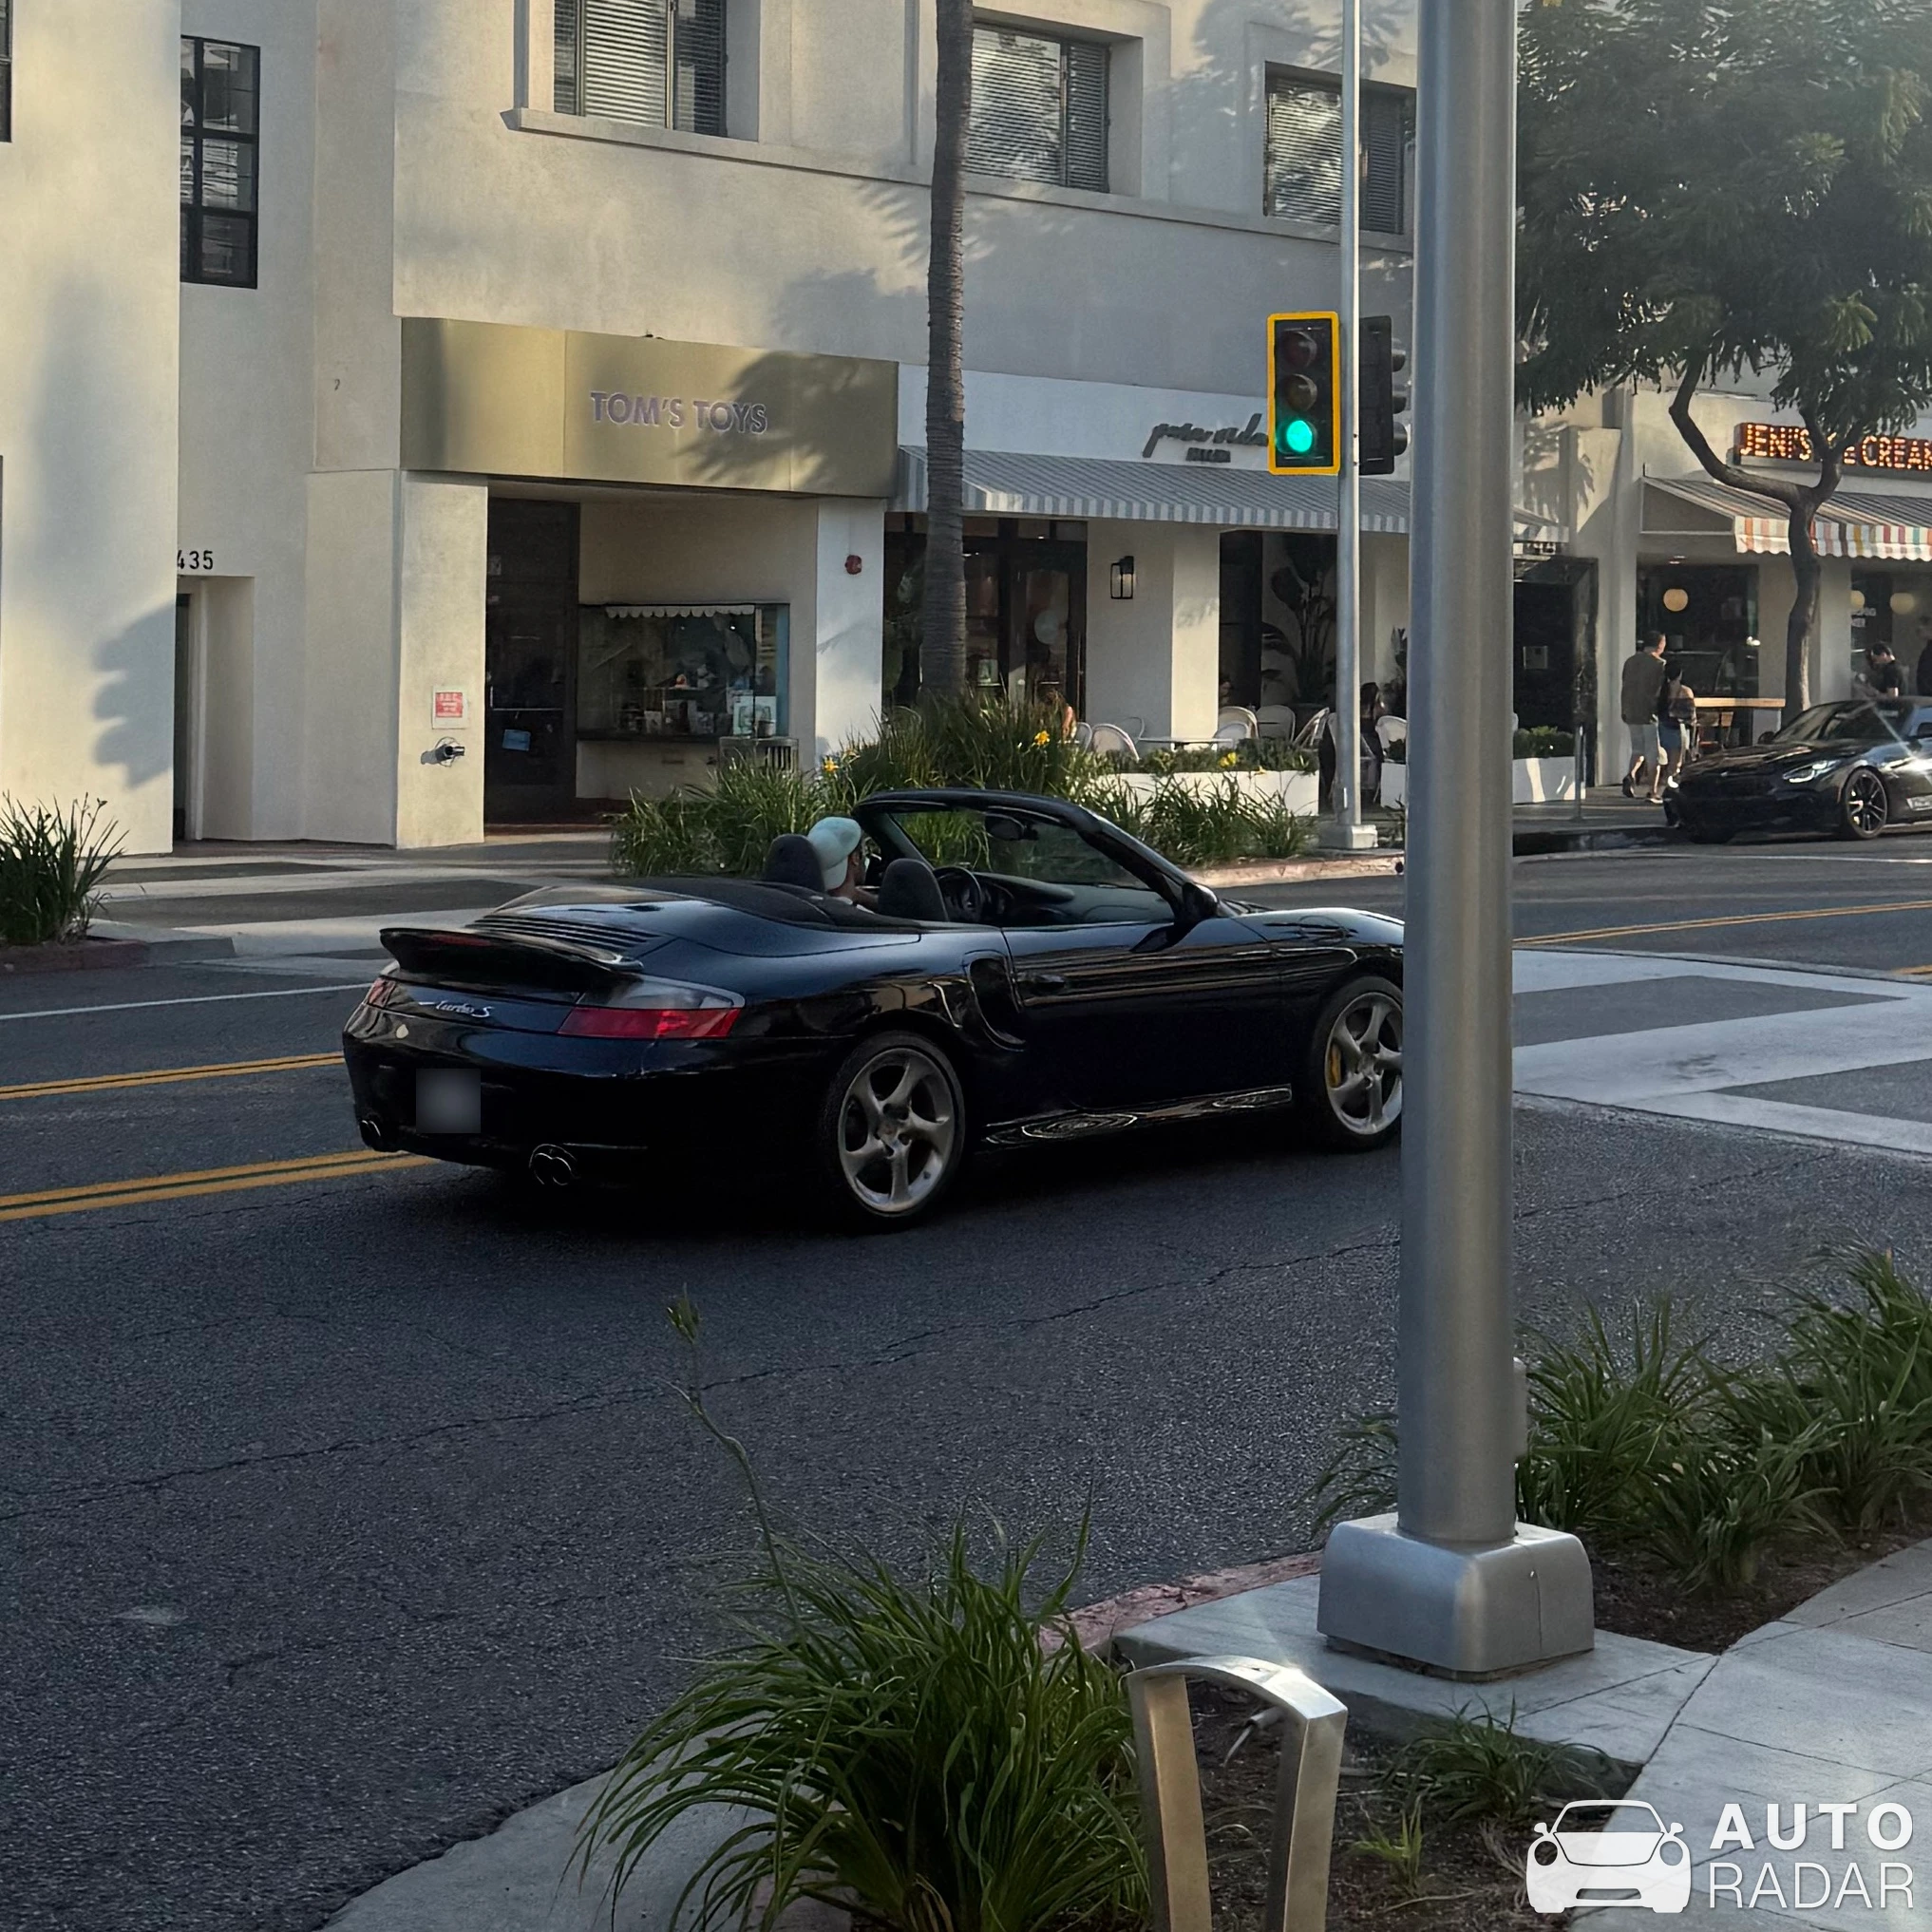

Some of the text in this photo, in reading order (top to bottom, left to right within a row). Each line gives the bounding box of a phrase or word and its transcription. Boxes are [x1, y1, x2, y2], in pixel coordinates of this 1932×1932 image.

[590, 391, 768, 435] TOM'S TOYS
[1739, 423, 1813, 462] JENI'S
